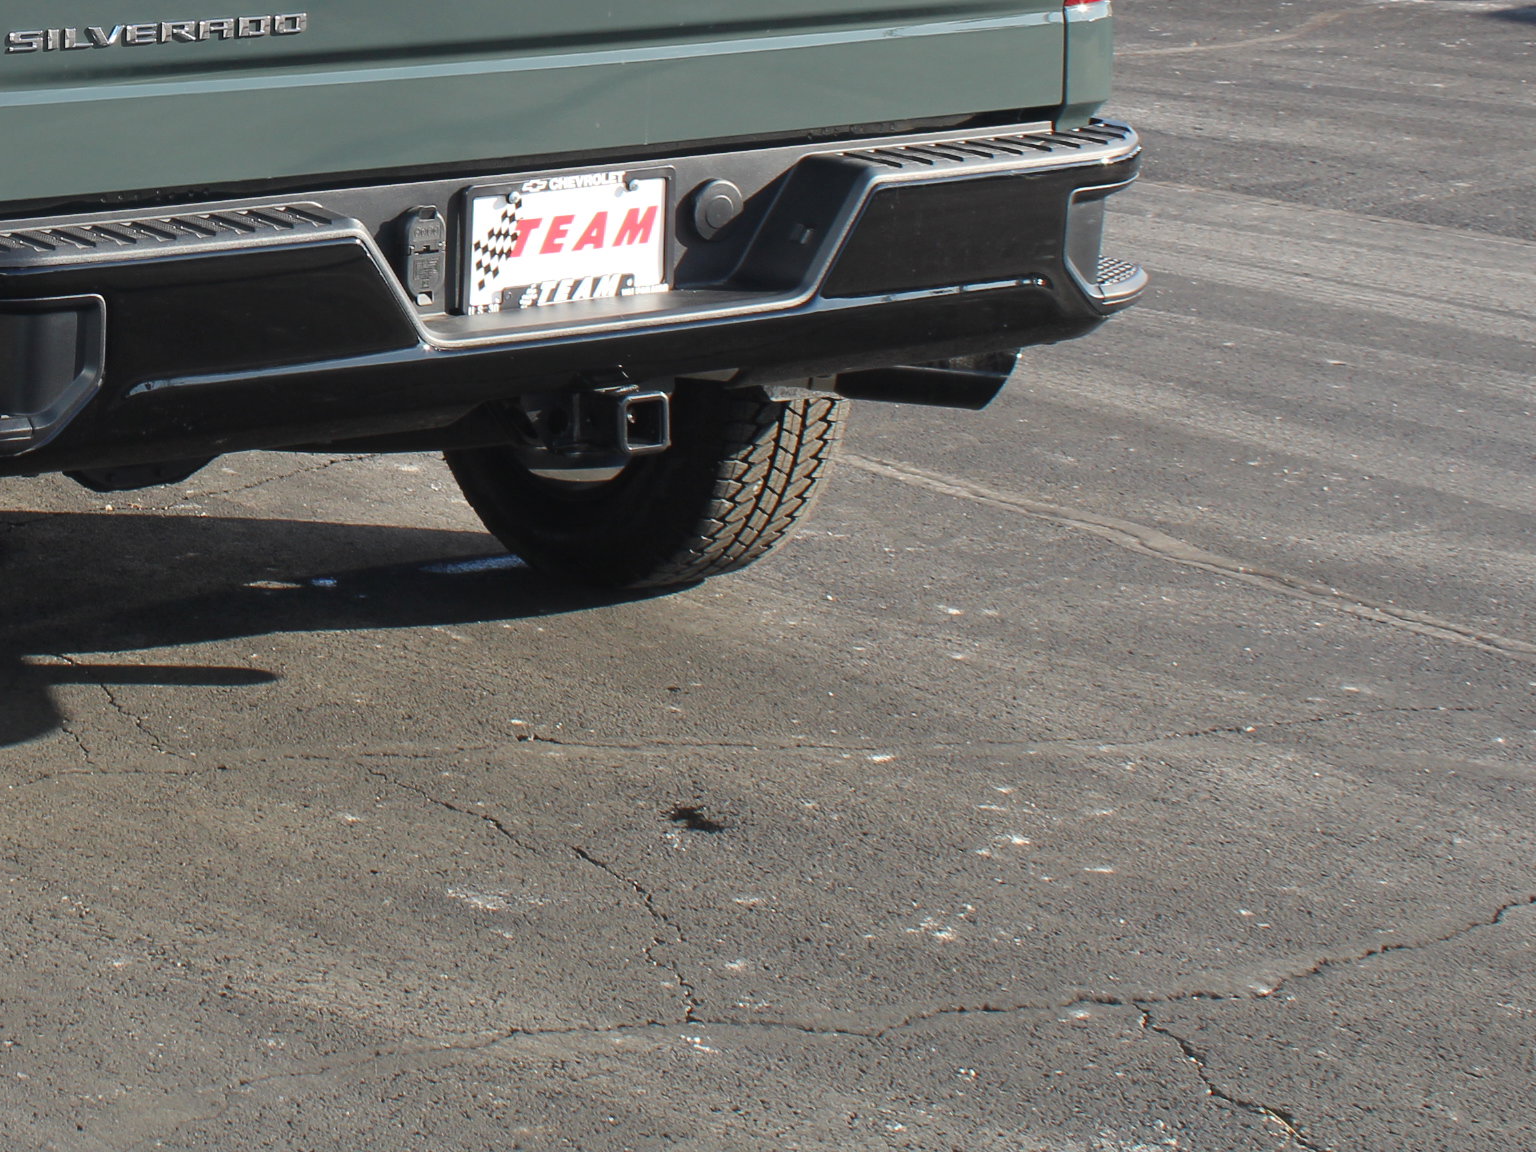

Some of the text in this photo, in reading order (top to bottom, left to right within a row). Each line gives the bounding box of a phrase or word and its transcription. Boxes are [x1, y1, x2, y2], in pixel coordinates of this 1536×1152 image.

[7, 12, 308, 53] SILVERADO
[548, 170, 626, 191] CHEVROLET
[508, 205, 659, 258] TEAM
[537, 272, 624, 306] TEAM
